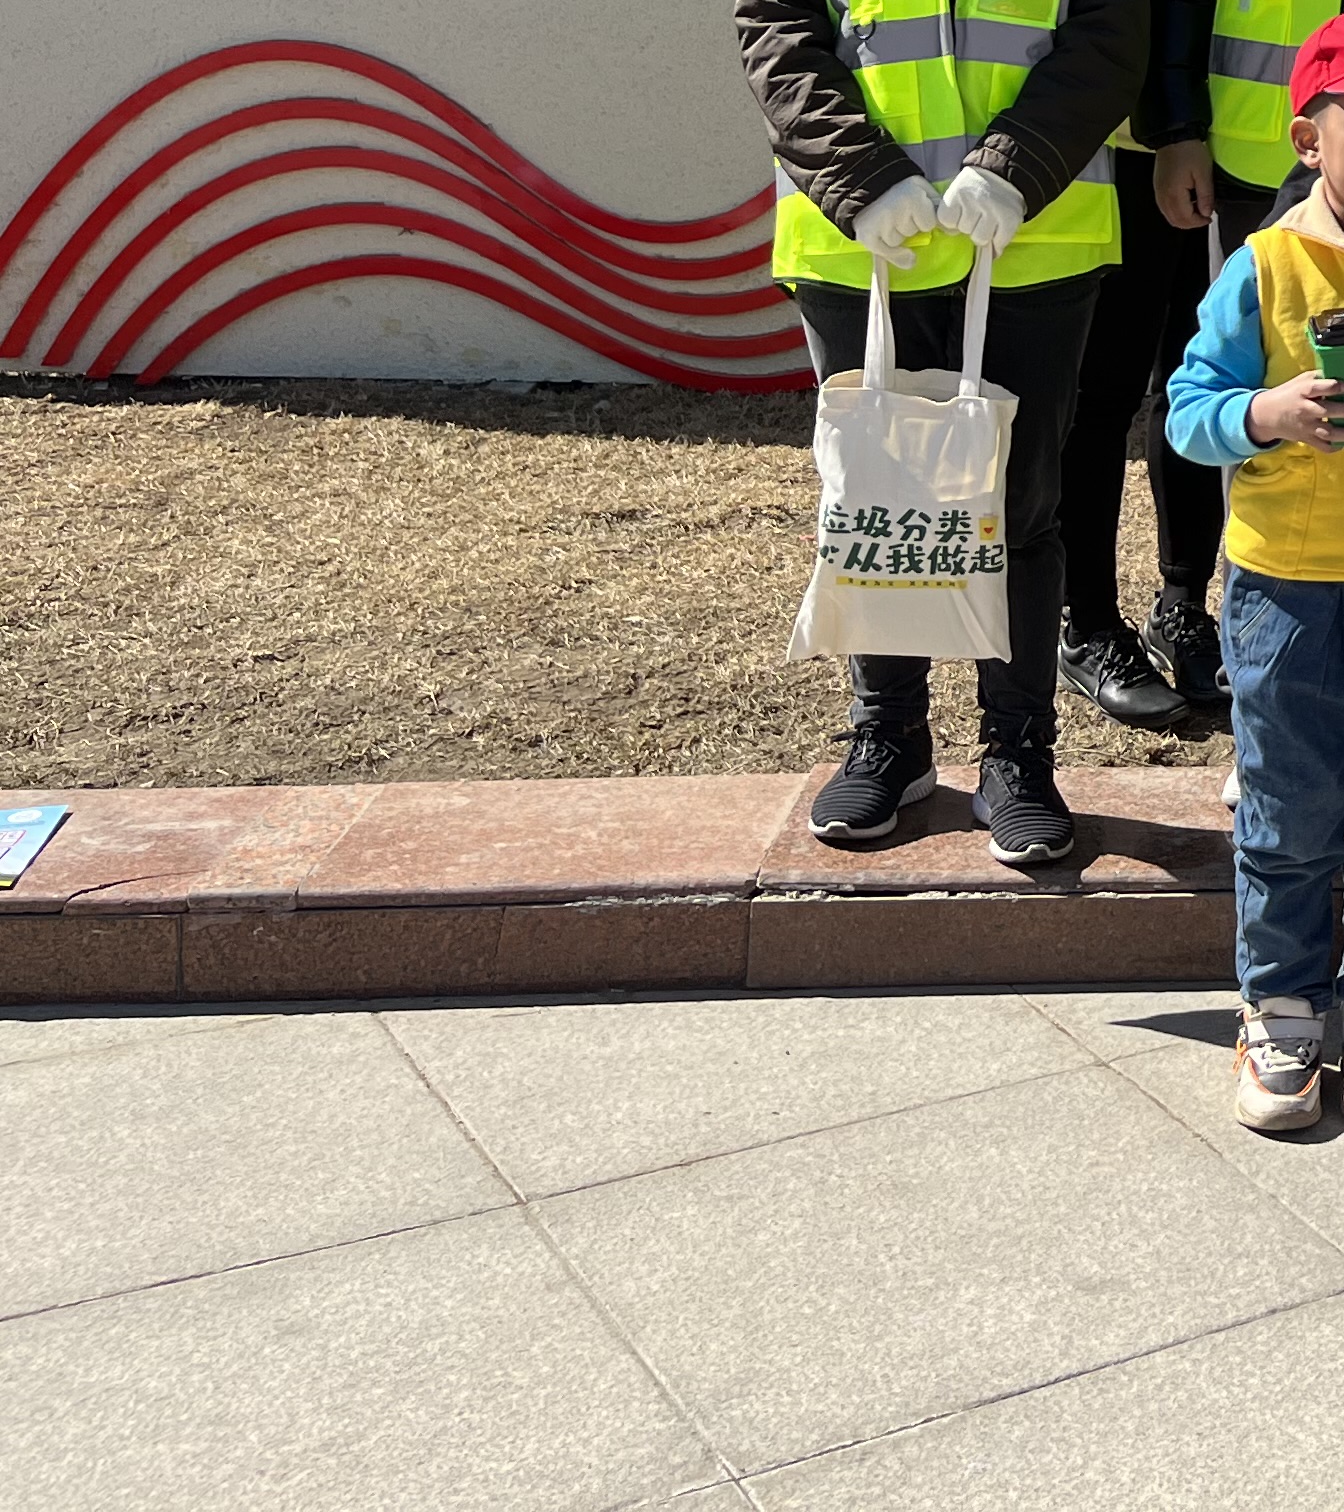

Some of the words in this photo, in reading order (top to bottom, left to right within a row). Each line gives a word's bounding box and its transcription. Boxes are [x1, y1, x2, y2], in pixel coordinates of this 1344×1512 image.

[821, 502, 974, 543] 垃圾分类
[843, 541, 1005, 576] 从我做起
